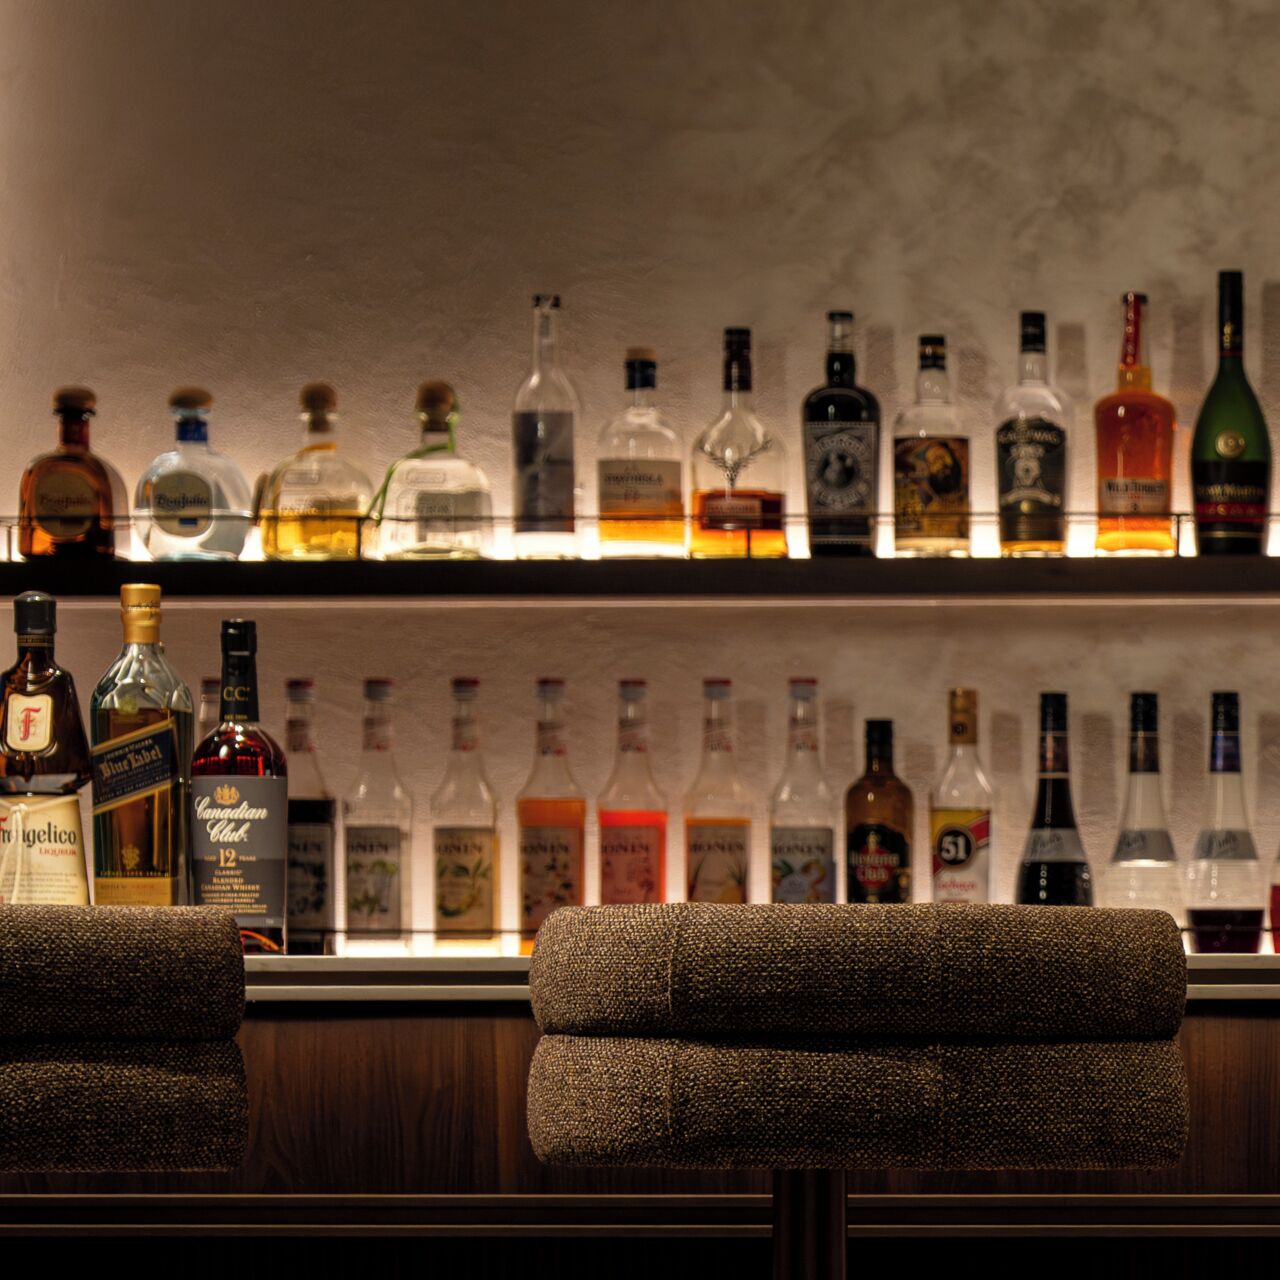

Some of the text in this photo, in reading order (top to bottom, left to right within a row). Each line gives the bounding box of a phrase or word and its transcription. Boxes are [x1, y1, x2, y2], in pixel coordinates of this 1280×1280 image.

[99, 758, 129, 780] Blue
[127, 744, 163, 769] Label
[194, 796, 268, 820] Canadian
[206, 820, 251, 843] Club
[218, 847, 237, 868] 12
[940, 835, 968, 862] 51
